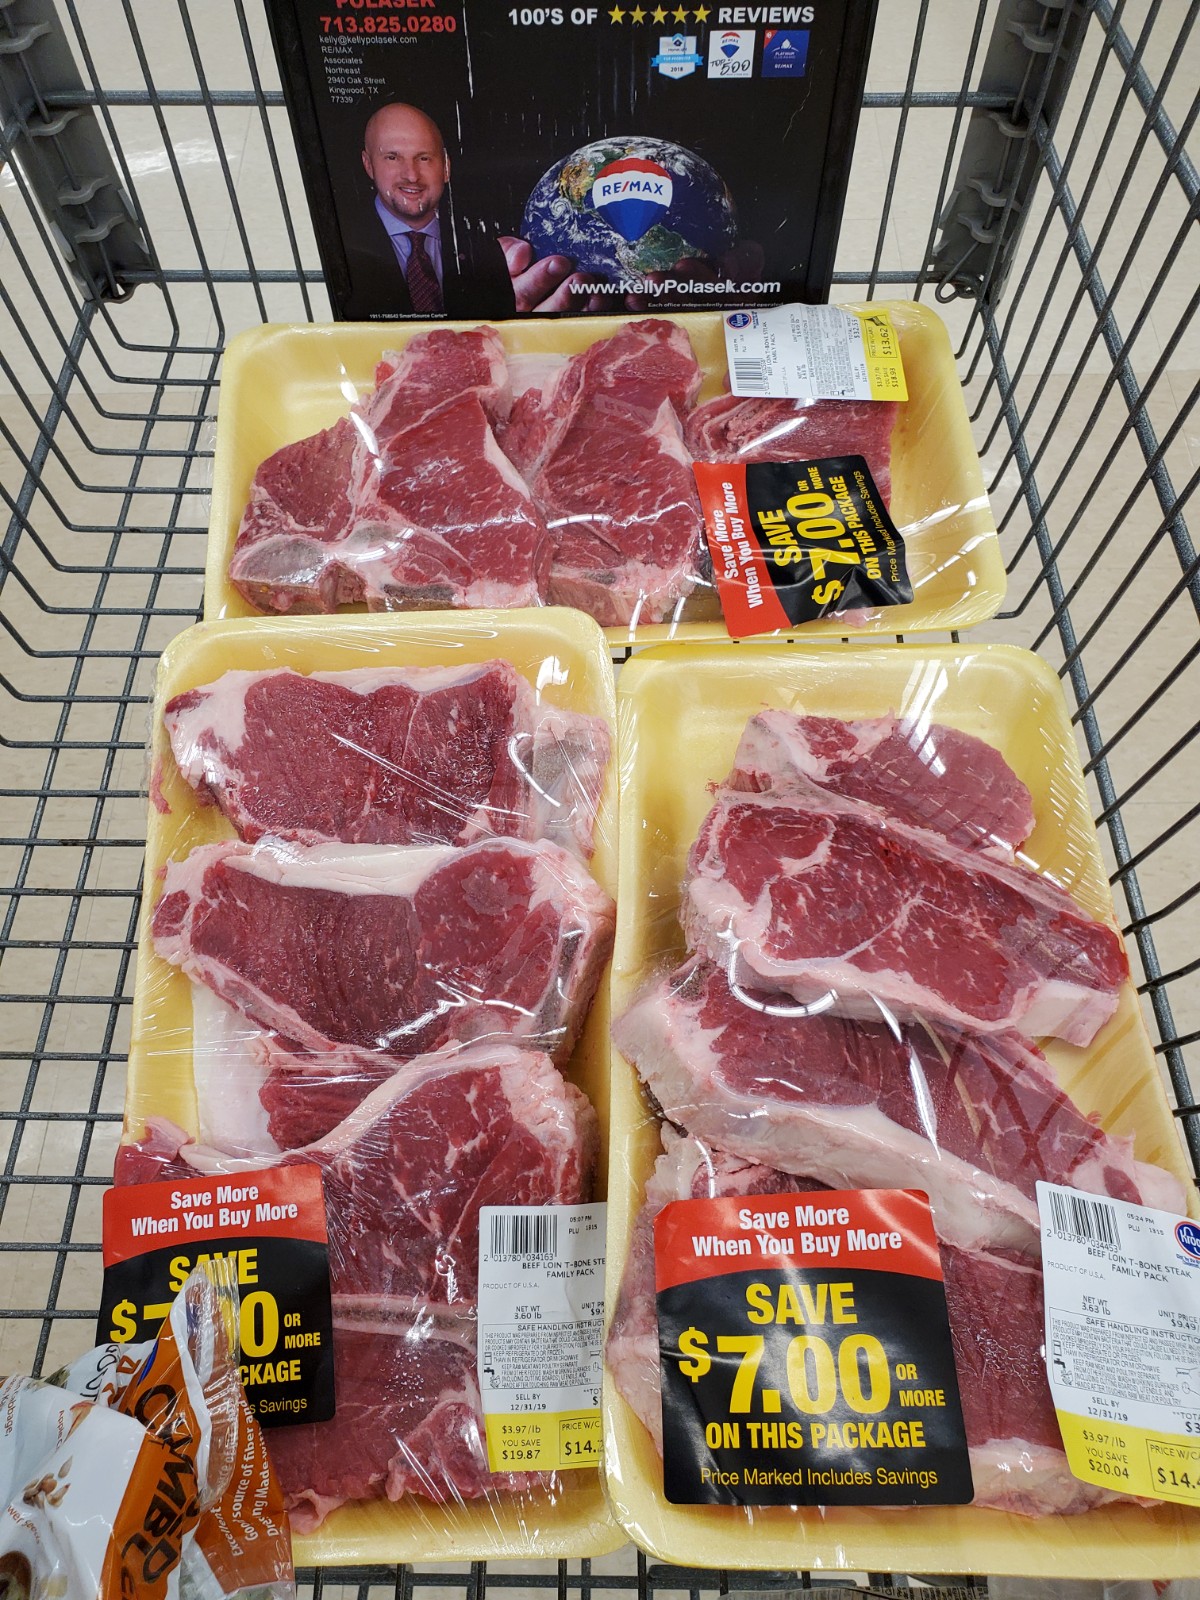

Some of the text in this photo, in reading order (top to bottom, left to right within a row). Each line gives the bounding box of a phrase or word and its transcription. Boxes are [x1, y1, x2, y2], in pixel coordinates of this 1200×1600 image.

[320, 16, 457, 33] 713.825.0280
[571, 8, 598, 25] OF
[718, 7, 815, 24] REVIEWS
[319, 35, 418, 46] kelly@kellypolasek.com
[321, 46, 353, 54] RE/MAX
[324, 56, 363, 64] Associates
[720, 59, 751, 76] 500
[325, 66, 361, 74] Northeast
[346, 76, 362, 84] Oak
[364, 76, 386, 84] Street
[368, 86, 379, 94] TX
[602, 181, 664, 197] RE/MAX
[569, 280, 781, 297] www.KellyPolasek.com
[880, 327, 892, 355] $13.62
[798, 480, 809, 492] OR
[808, 466, 825, 490] MORE
[829, 476, 882, 580] ON THIS PACKAGE
[854, 470, 901, 583] Price Marked Includes Savings
[714, 510, 739, 580] Save More
[722, 482, 764, 609] When You Buy More
[757, 509, 802, 567] SAVE
[786, 492, 861, 605] $7.00
[170, 1184, 259, 1210] Save More
[131, 1202, 298, 1237] When You Buy More
[739, 1206, 850, 1230] Save More
[1126, 1212, 1144, 1222] 05:24
[1128, 1224, 1140, 1232] PLU
[692, 1229, 902, 1257] When You Buy More
[1046, 1228, 1118, 1253] 2 013780 034453
[484, 1253, 554, 1262] 2 013780 034163
[522, 1262, 541, 1270] BEEF
[564, 1259, 592, 1268] T-BONE
[1088, 1247, 1106, 1258] BEEF
[1108, 1252, 1126, 1264] LOIN
[1128, 1258, 1162, 1272] T-BONE
[1165, 1266, 1192, 1279] STEAK
[546, 1268, 595, 1278] FAMILY PACK
[1047, 1260, 1078, 1274] PRODUCT
[1112, 1264, 1168, 1282] FAMILY PACK
[482, 1282, 512, 1290] PRODUCT
[582, 1302, 595, 1310] UNIT
[746, 1282, 858, 1325] SAVE
[1082, 1295, 1198, 1324] NET WT UNIT PRICE
[284, 1313, 302, 1328] OR
[514, 1312, 532, 1320] 3.60
[1082, 1302, 1196, 1330] 3.63 lb $9.49
[518, 1320, 605, 1332] SAFE HANDLING INSTRUCT
[1086, 1318, 1200, 1344] SAFE HANDLING INSTRUCTIO
[284, 1332, 321, 1349] MORE
[240, 1360, 302, 1387] CKAGE
[678, 1326, 892, 1415] $7.00
[896, 1364, 918, 1380] OR
[258, 1396, 308, 1414] Savings
[510, 1403, 547, 1411] 12/31/19
[900, 1390, 946, 1407] MORE
[1092, 1396, 1120, 1408] SELL BY
[1088, 1406, 1128, 1422] 12/31/19
[562, 1422, 582, 1431] PRICE
[584, 1420, 600, 1430] W/C
[706, 1421, 926, 1449] ON THIS PACKAGE
[244, 1426, 255, 1462] fiber
[1150, 1444, 1176, 1458] PRICE
[502, 1450, 541, 1460] $19.87
[1086, 1446, 1128, 1464] YOU SAVE
[241, 1464, 254, 1478] of
[701, 1467, 938, 1488] Price Marked Includes Savings
[1088, 1459, 1130, 1480] $20.04
[232, 1478, 250, 1519] source
[210, 1506, 244, 1557] Excellent
